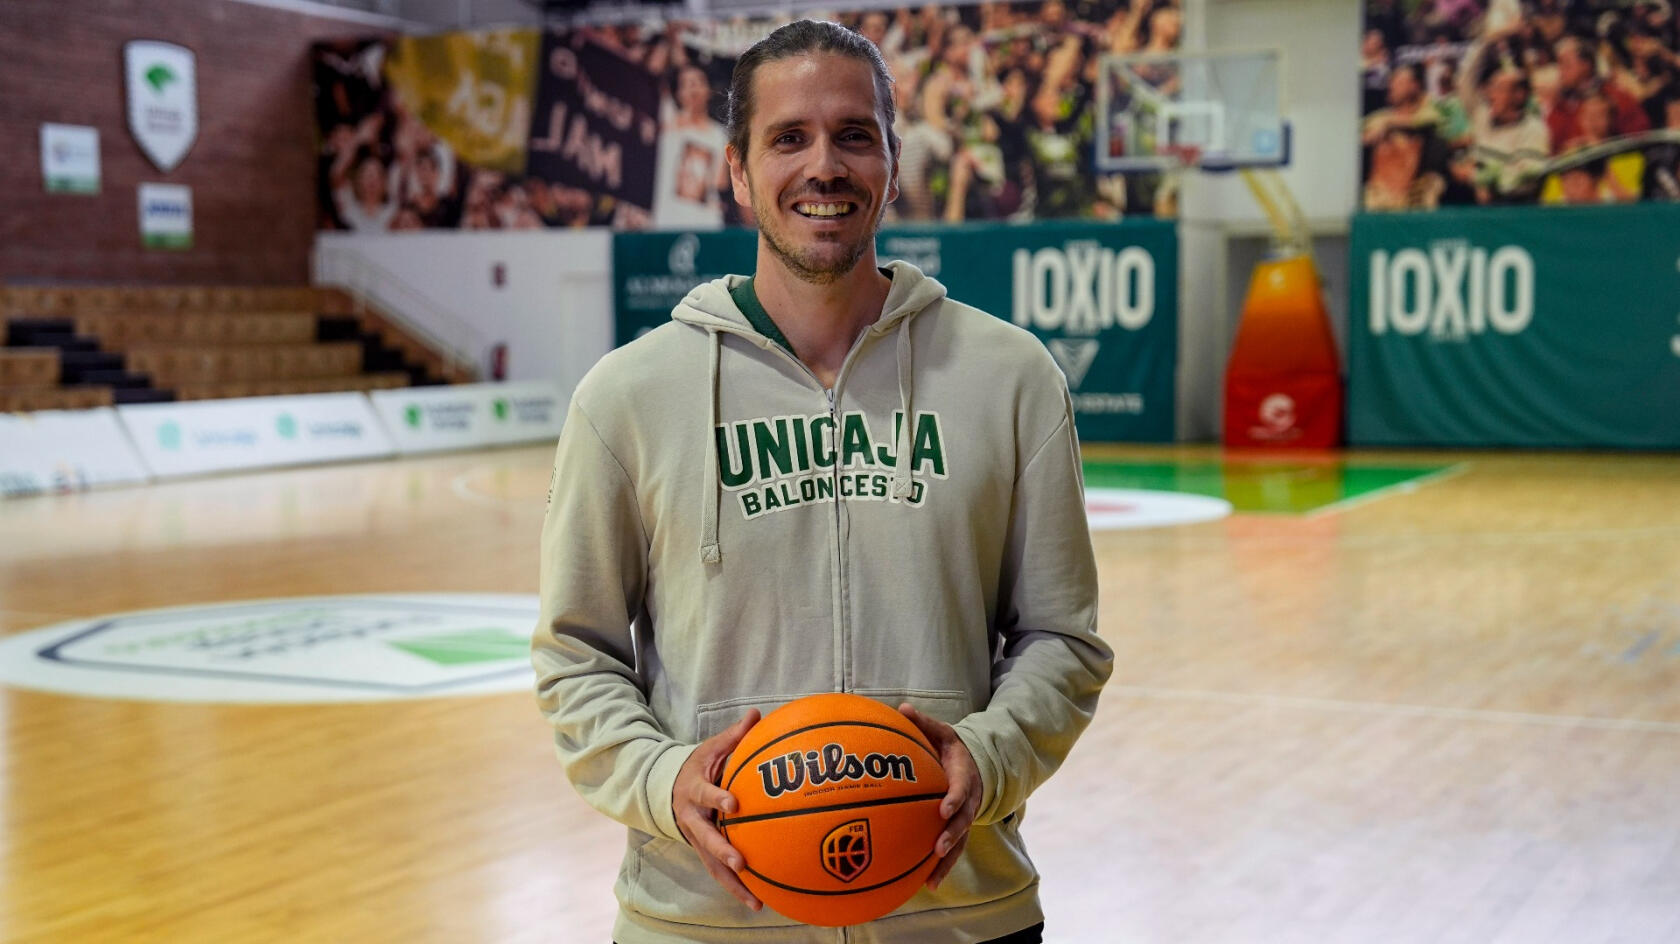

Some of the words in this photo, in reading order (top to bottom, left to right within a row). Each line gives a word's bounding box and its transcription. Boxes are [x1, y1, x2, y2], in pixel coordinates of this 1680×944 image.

[714, 411, 948, 490] UNICAJA
[741, 473, 925, 517] BALONCESO
[757, 743, 918, 799] Wilson
